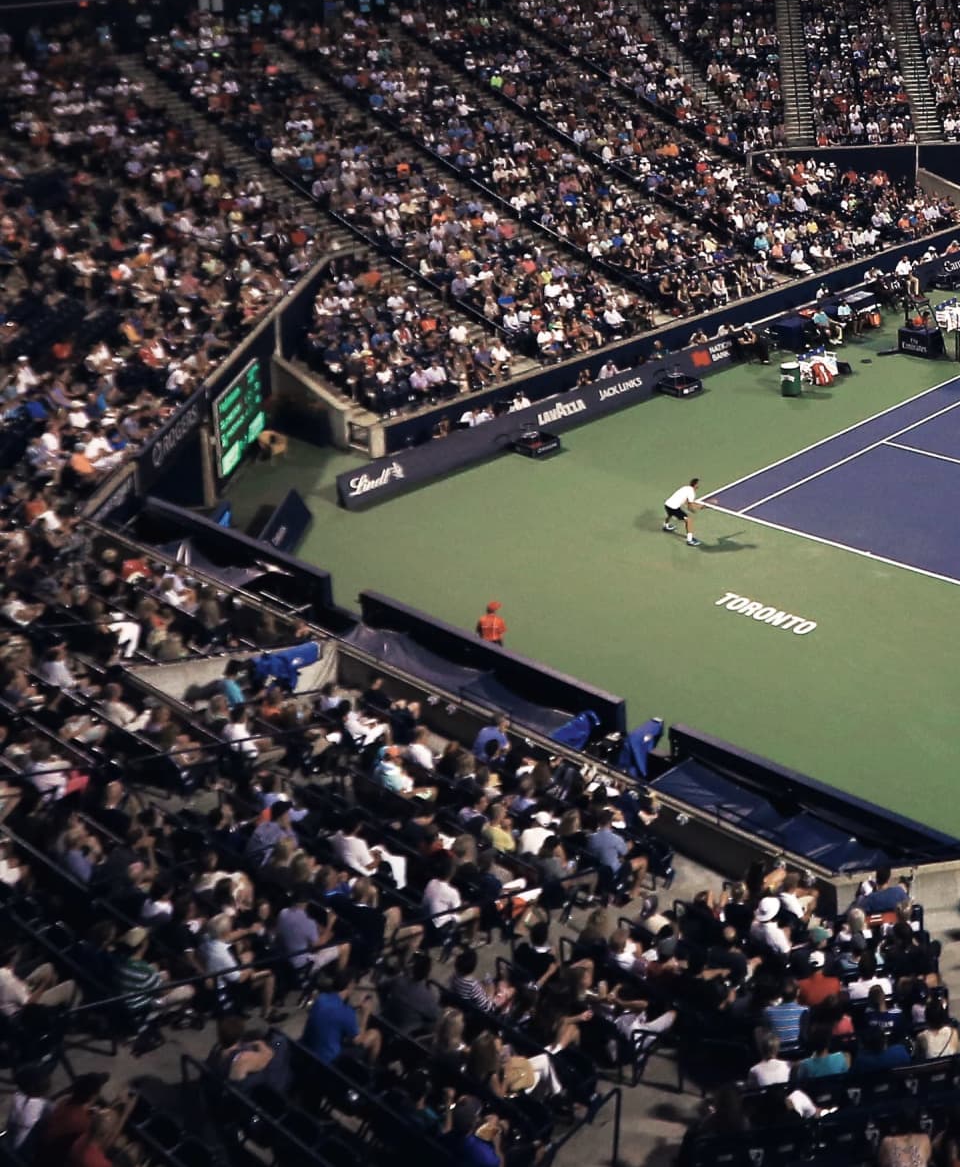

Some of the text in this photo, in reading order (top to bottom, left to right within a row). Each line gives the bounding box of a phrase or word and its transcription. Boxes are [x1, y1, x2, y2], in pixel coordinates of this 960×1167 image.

[599, 386, 619, 402] JACK
[537, 398, 588, 426] LAVAZZA
[349, 467, 392, 496] Lindt
[715, 592, 817, 635] TORONTO
